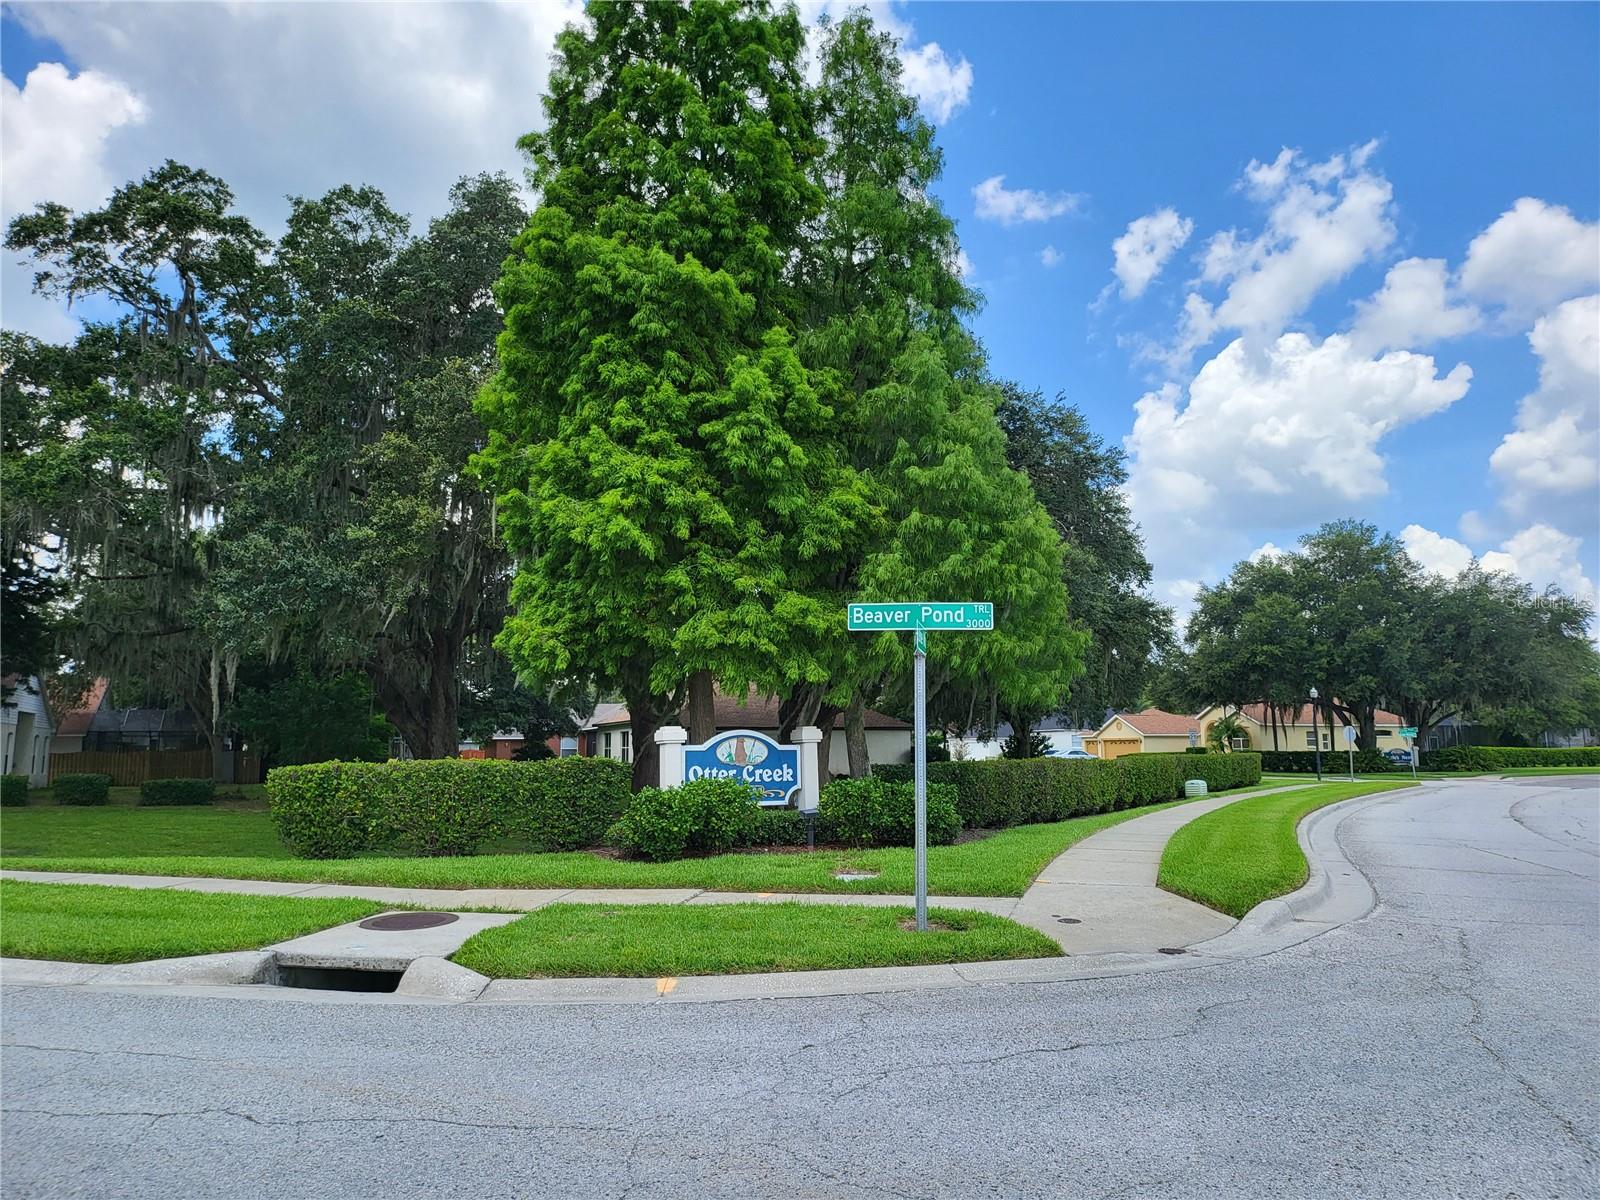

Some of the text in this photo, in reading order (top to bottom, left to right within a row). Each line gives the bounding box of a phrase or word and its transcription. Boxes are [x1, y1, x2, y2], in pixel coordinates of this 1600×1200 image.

[853, 604, 990, 623] Beaver Pond TRL
[966, 619, 991, 628] 3000
[688, 763, 794, 782] Otter Creek
